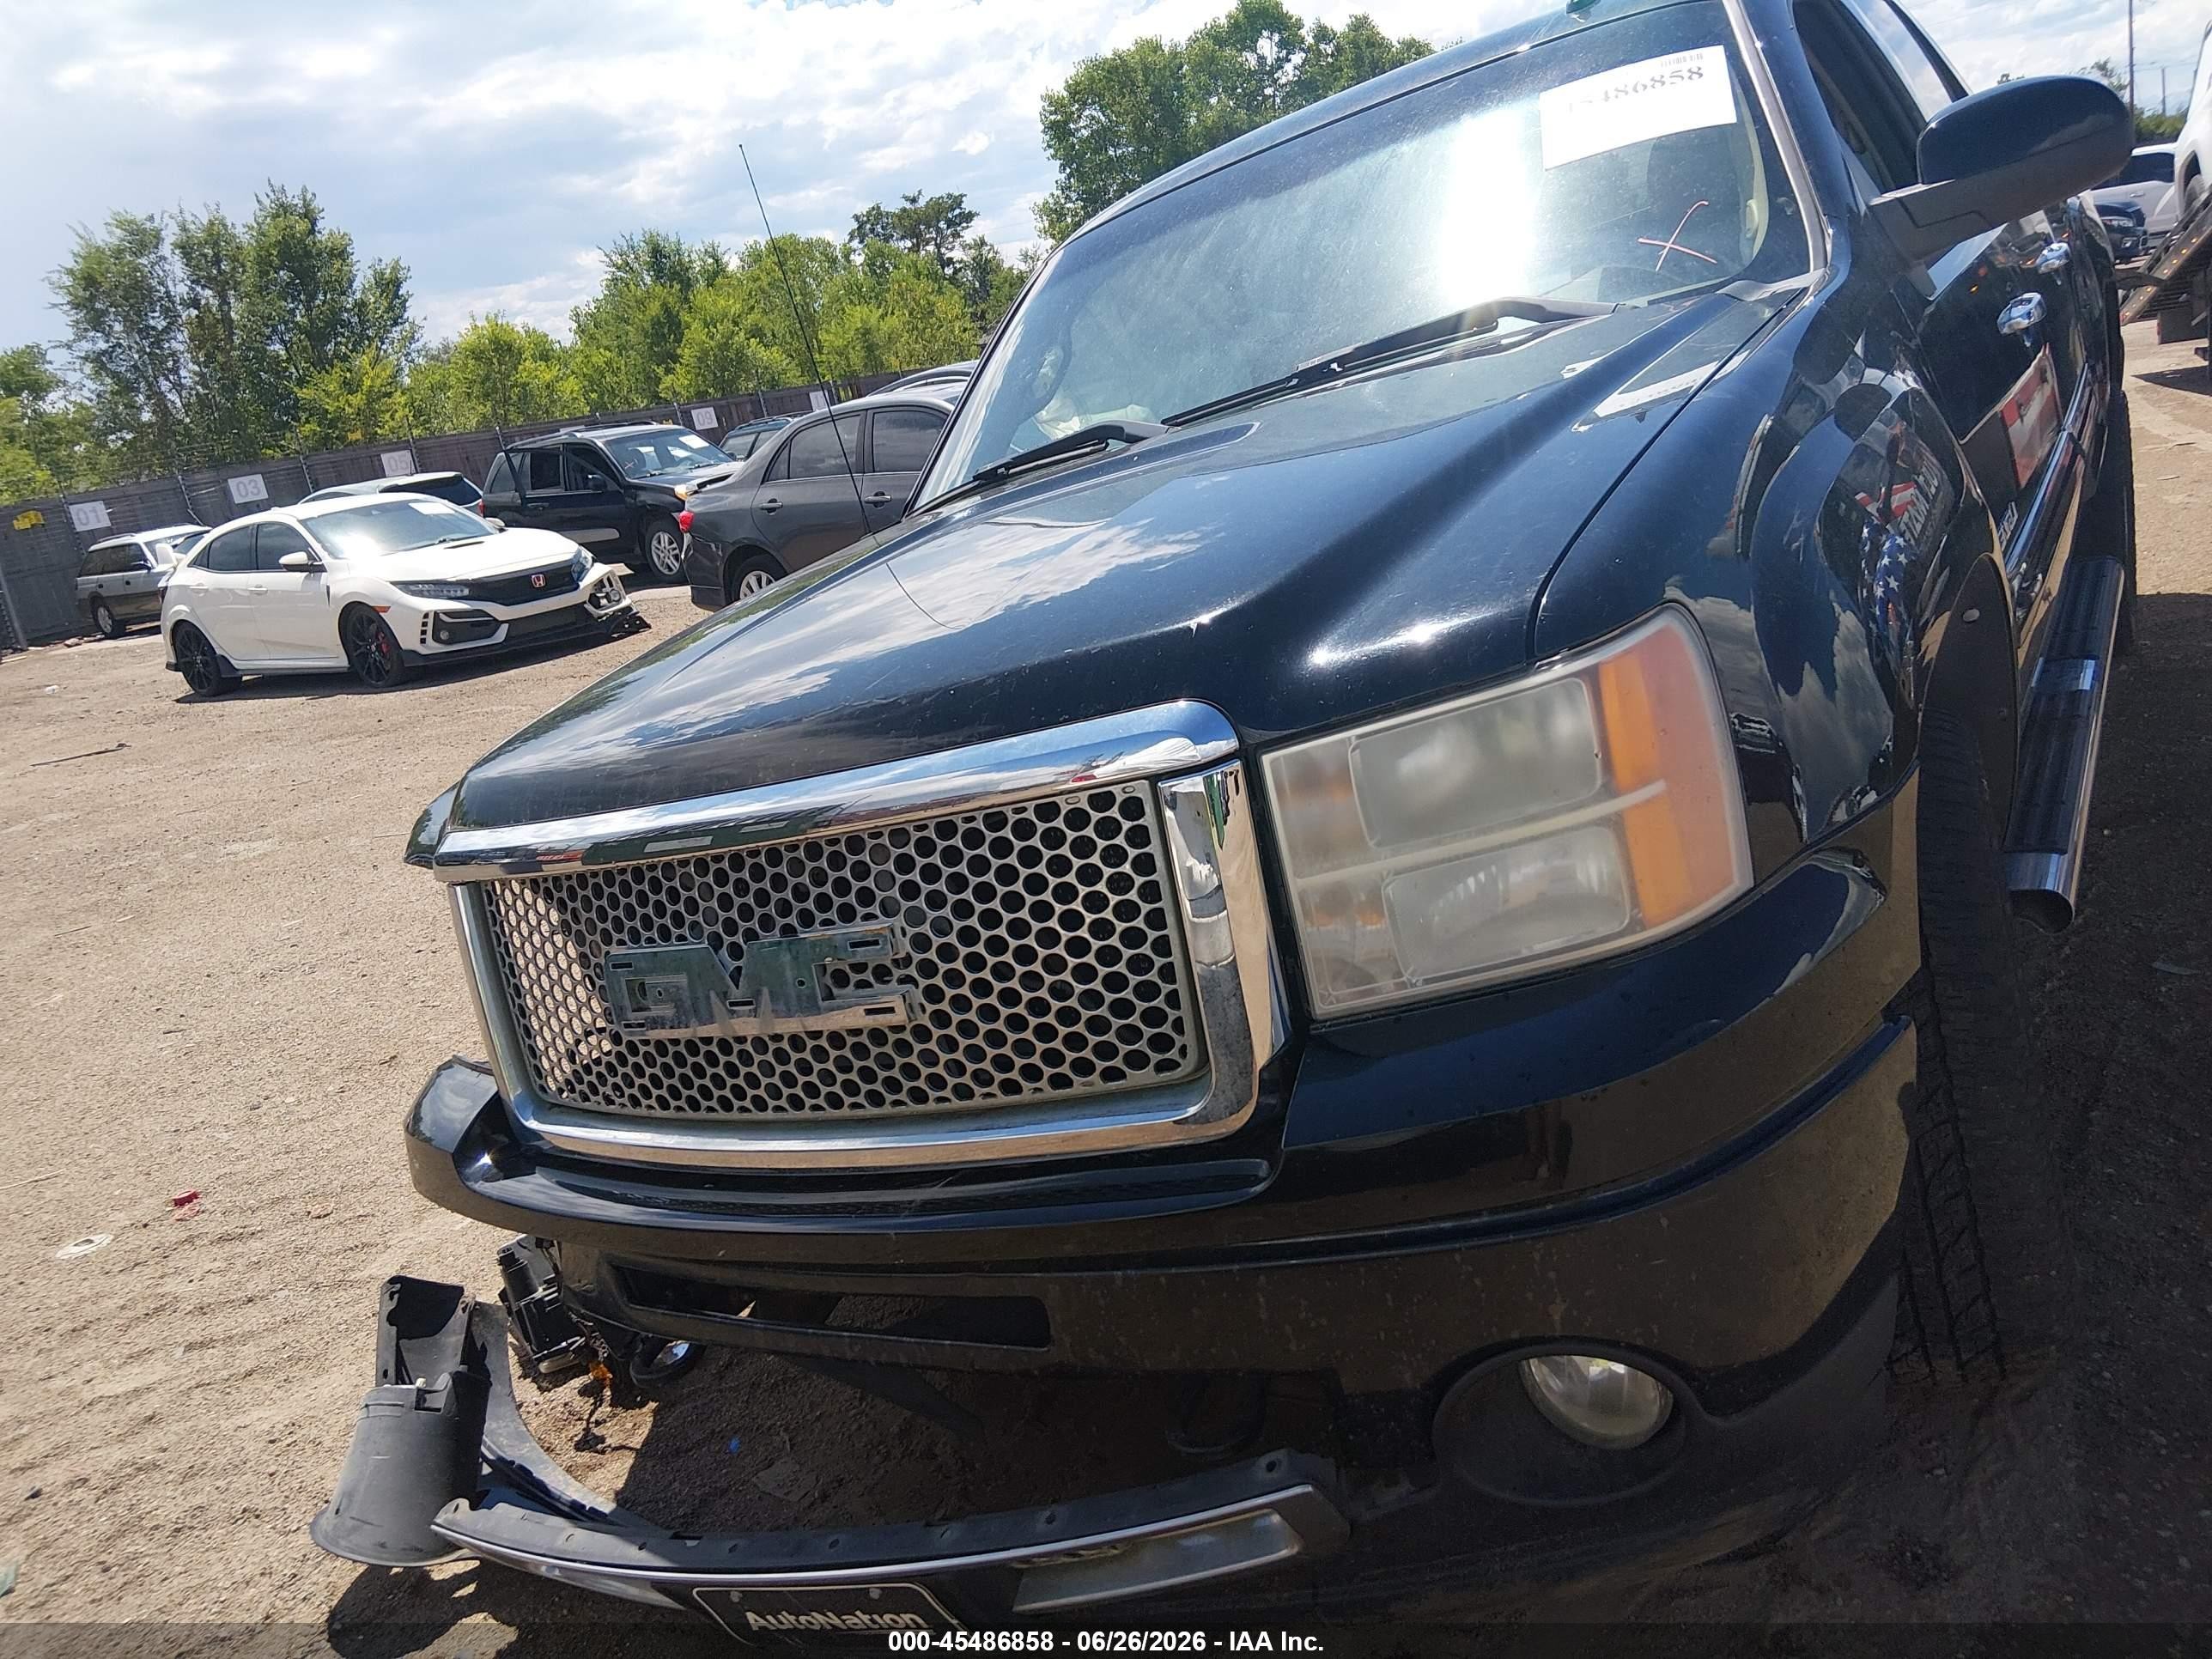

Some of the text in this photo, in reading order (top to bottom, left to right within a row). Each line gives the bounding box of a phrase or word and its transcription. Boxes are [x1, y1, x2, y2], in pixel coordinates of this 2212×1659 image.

[696, 411, 714, 427] 09
[387, 454, 410, 472] 05
[235, 478, 262, 499] 03
[76, 507, 102, 526] 01
[744, 1609, 930, 1631] AutoNation
